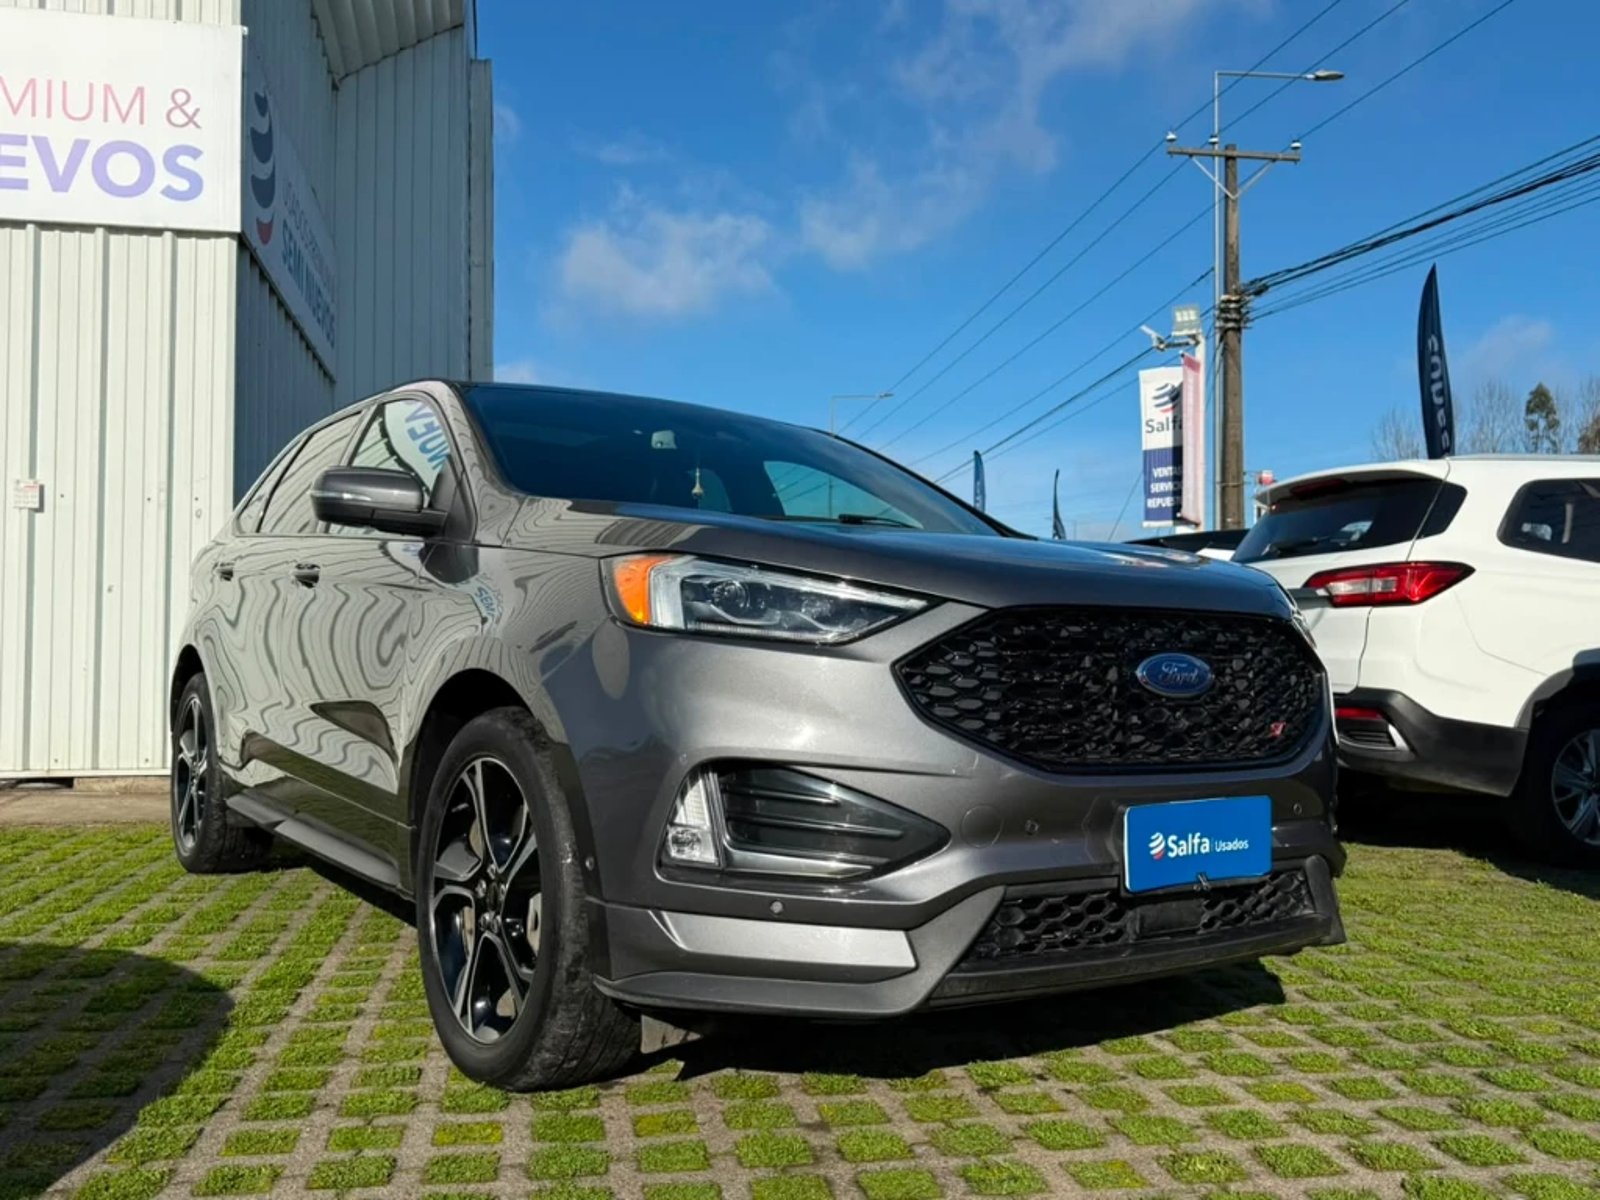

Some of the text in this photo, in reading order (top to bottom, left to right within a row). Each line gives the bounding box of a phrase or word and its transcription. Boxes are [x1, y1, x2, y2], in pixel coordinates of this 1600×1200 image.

[165, 87, 203, 129] &
[1159, 660, 1199, 686] Ford
[1167, 832, 1249, 858] Salfa Usados
